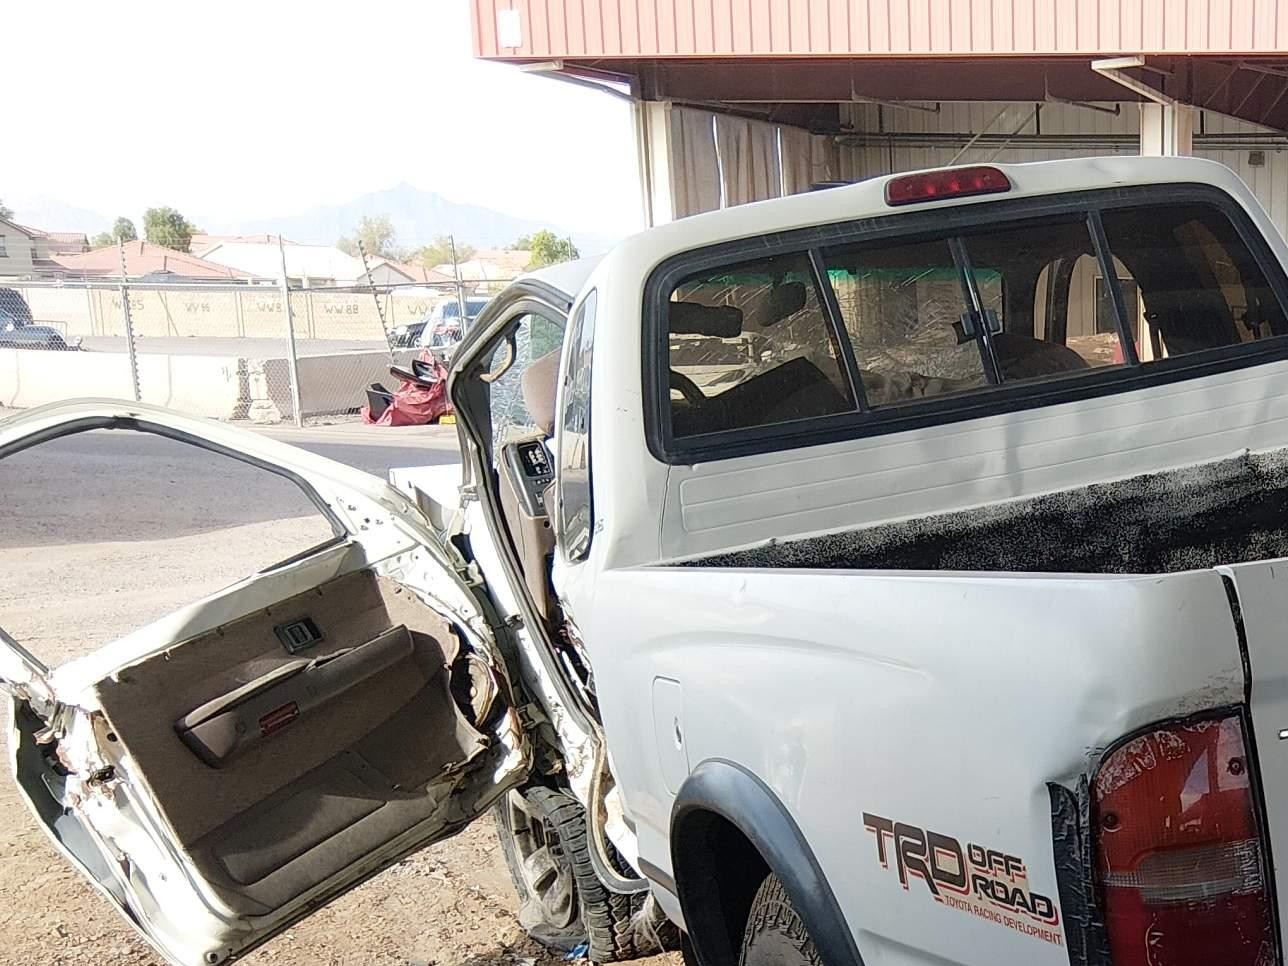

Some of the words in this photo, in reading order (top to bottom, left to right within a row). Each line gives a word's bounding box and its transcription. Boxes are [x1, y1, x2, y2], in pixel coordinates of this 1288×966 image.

[863, 812, 969, 902] TRD
[967, 843, 1025, 881] OFF
[944, 895, 973, 914] TOYOTA
[974, 904, 1002, 923] RACING
[1003, 916, 1062, 945] DEVELOPMENT
[972, 874, 1058, 925] ROAD
